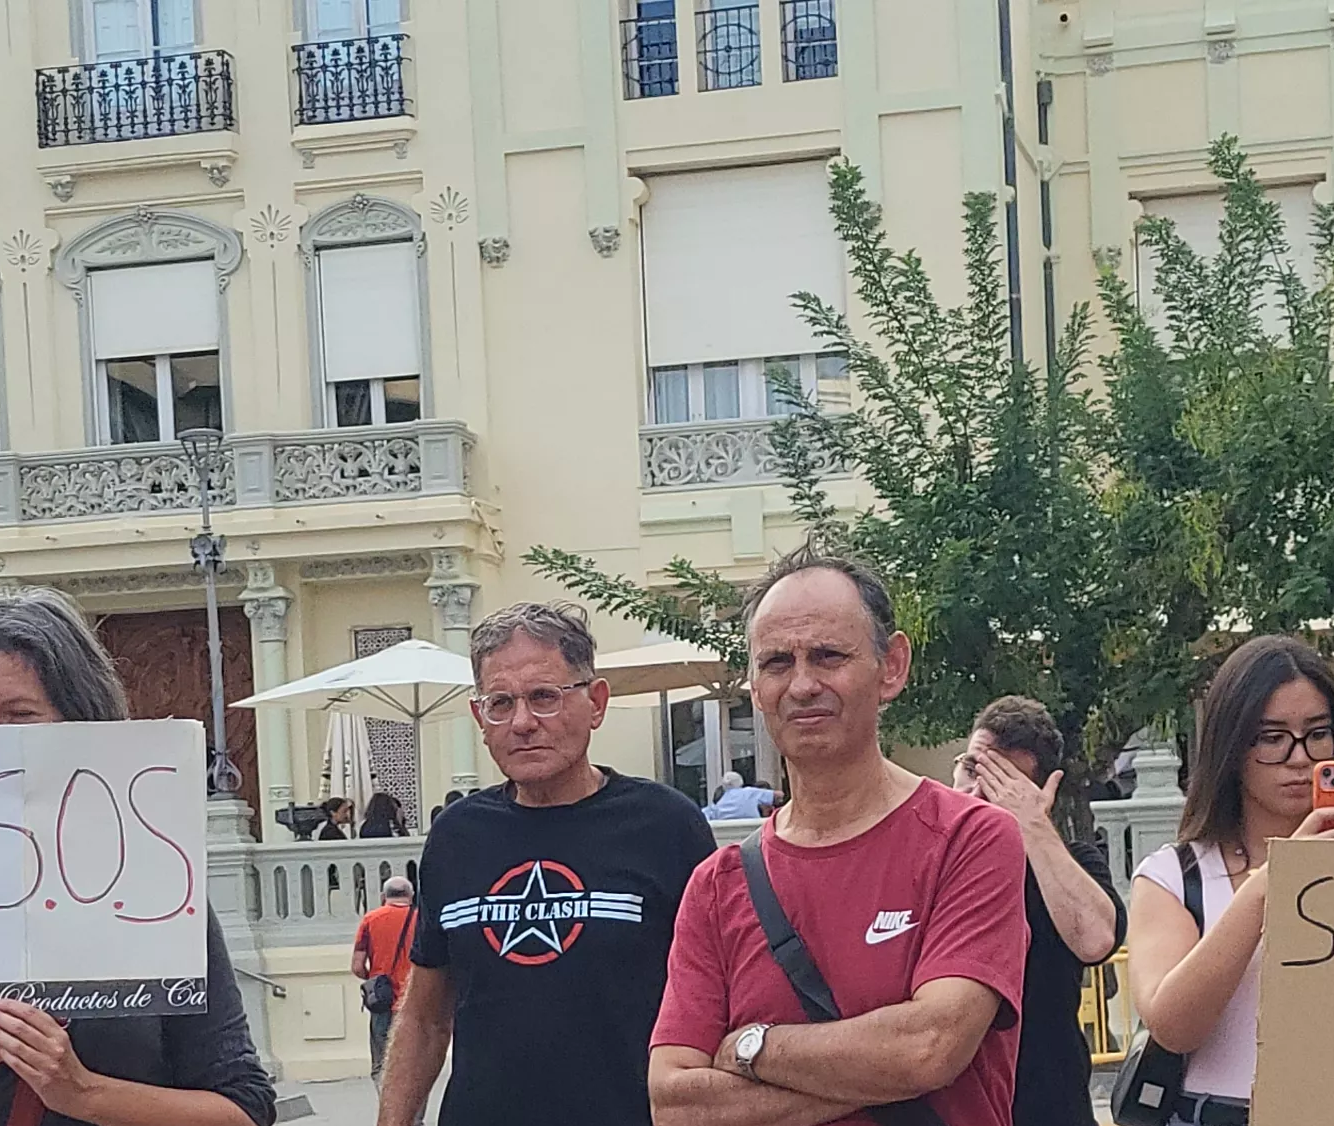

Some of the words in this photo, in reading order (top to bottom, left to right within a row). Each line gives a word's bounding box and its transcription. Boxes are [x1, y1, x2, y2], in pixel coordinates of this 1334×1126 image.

[479, 904, 521, 922] THE
[524, 900, 589, 921] CLASH
[873, 910, 913, 930] NIKE
[123, 983, 152, 1008] de
